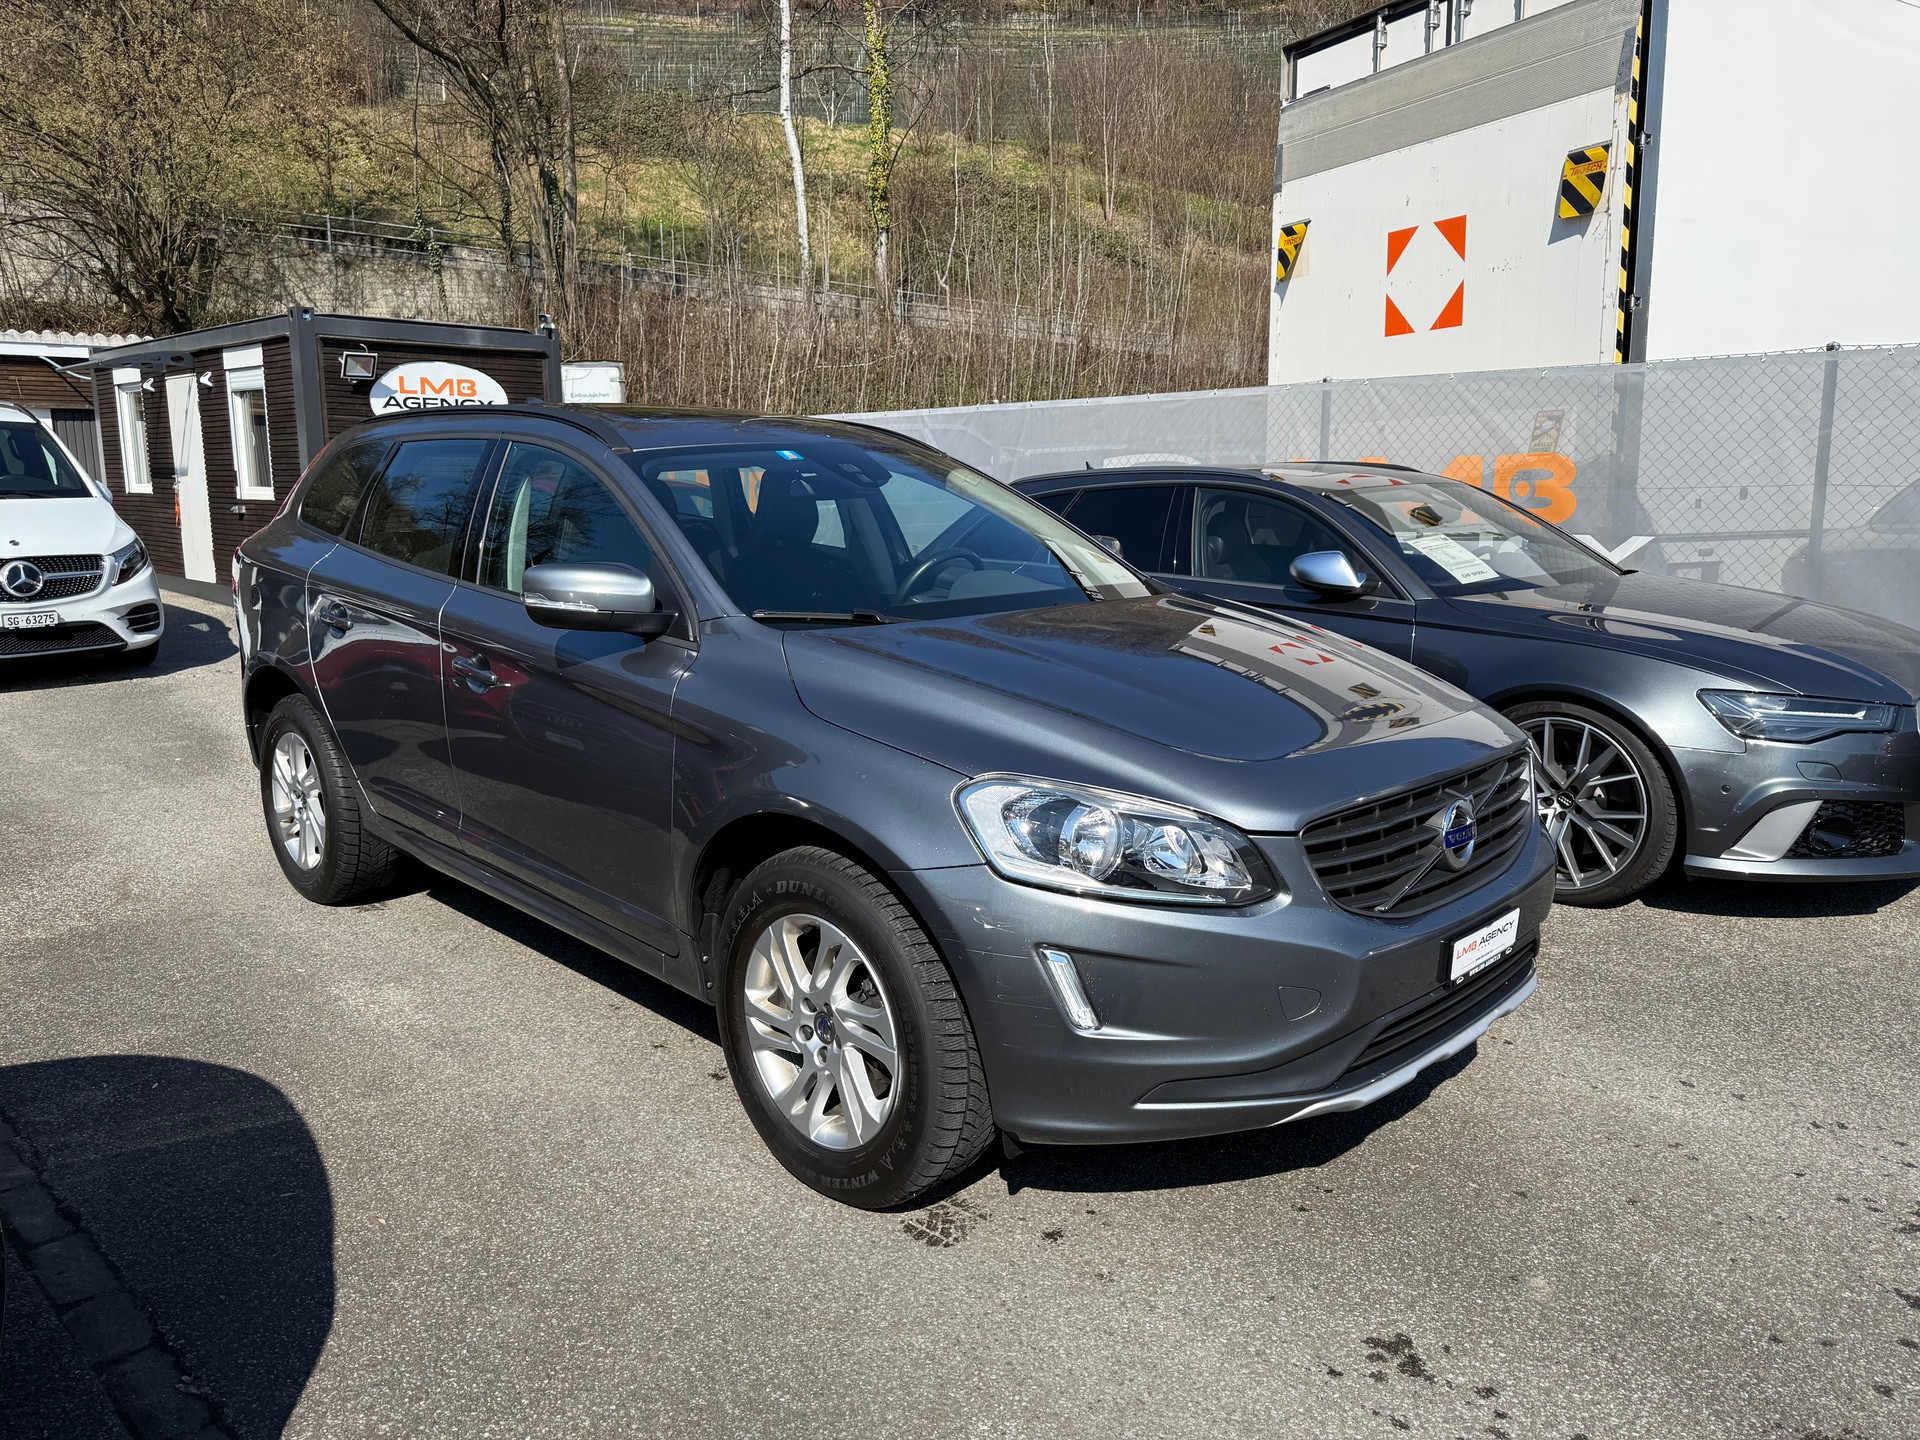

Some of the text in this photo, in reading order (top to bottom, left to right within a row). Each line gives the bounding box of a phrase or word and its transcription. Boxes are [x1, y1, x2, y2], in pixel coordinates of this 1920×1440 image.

[398, 375, 477, 398] LMB
[25, 613, 55, 625] 63275
[1456, 939, 1478, 960] LMB
[1478, 918, 1516, 947] AGENCY
